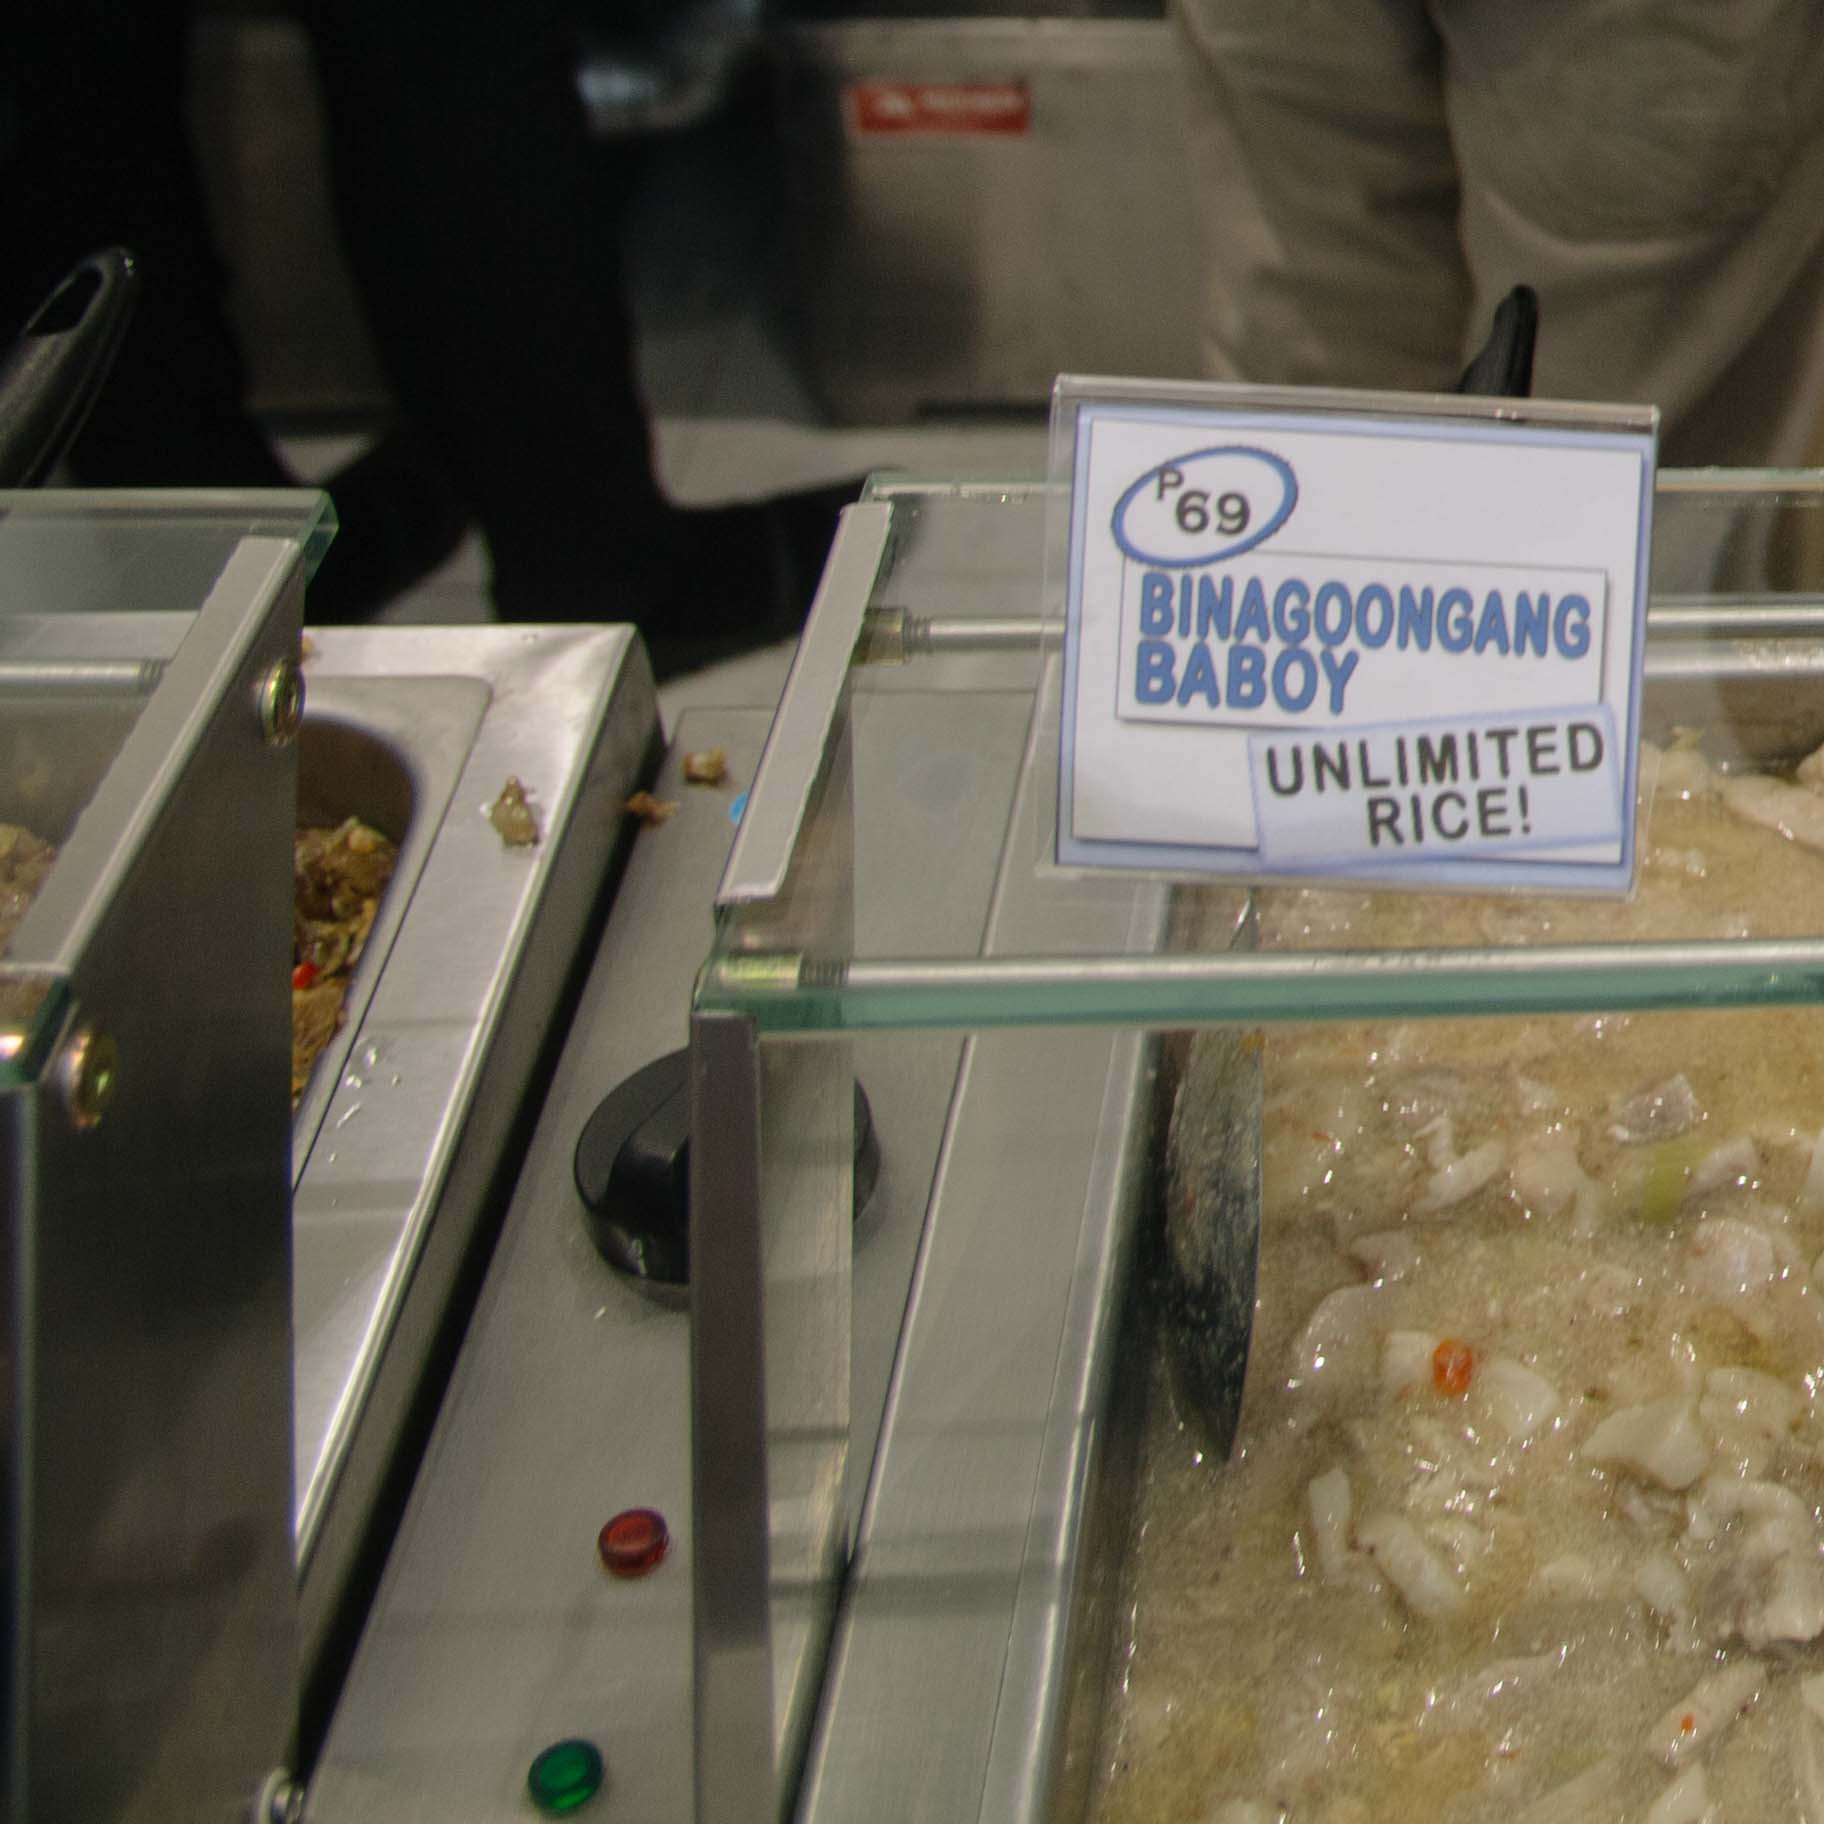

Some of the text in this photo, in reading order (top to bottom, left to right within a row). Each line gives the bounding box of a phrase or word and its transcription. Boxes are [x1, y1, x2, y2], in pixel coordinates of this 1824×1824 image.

[1139, 572, 1592, 660] BINAGOONGANG
[1134, 640, 1360, 716] BABOY
[1266, 722, 1604, 797] UNLIMITED
[1367, 785, 1532, 847] RICE!
